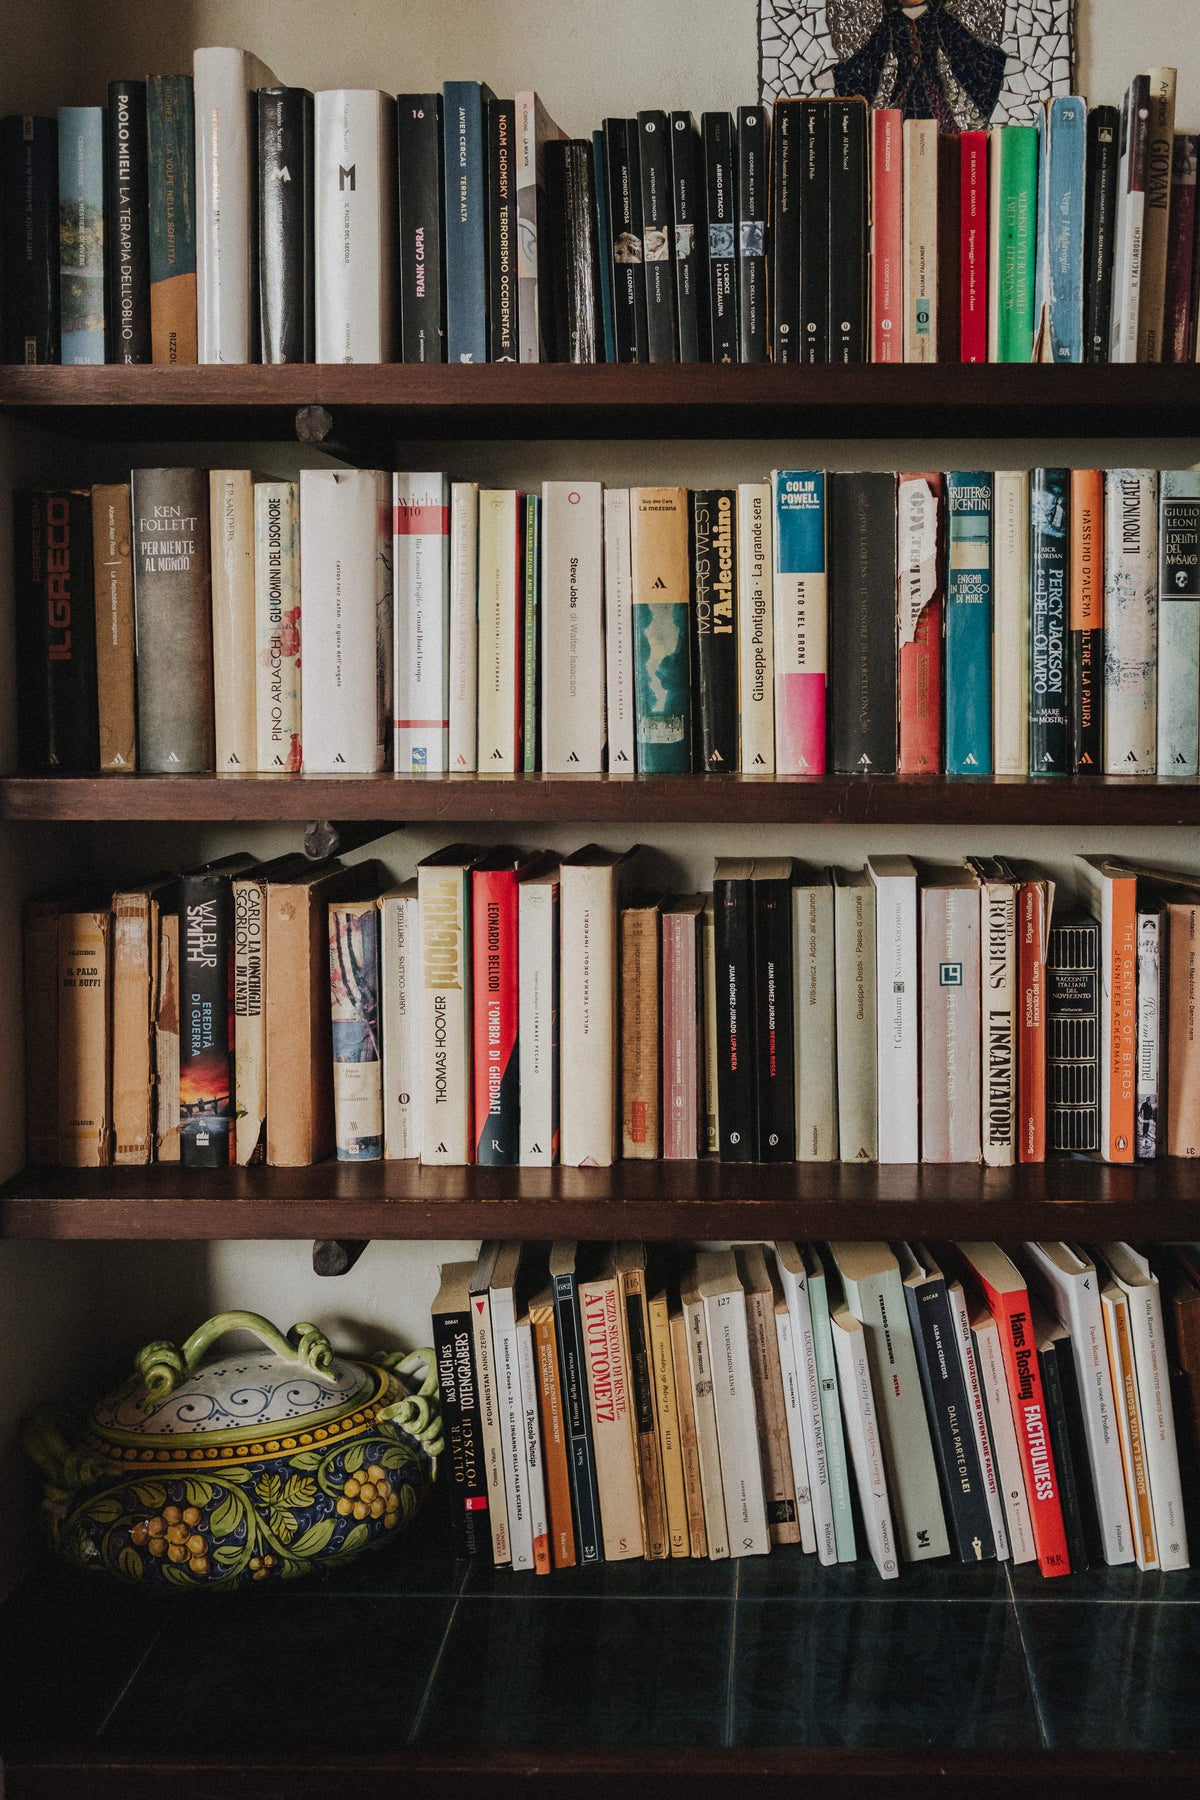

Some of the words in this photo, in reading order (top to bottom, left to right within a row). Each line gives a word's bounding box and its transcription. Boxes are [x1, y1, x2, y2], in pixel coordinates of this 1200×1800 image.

[118, 95, 130, 140] PAOLO
[412, 109, 424, 119] 16
[1062, 111, 1074, 120] 79
[119, 143, 131, 180] MIELI
[339, 164, 356, 191] M
[499, 149, 508, 199] CHOMSKY
[1149, 140, 1170, 209] GIOVANI
[120, 186, 131, 203] LA
[120, 207, 132, 262] TERAPIA
[416, 227, 424, 260] CAPRA
[500, 206, 508, 272] TERRORISMO
[416, 263, 425, 297] FRANK
[121, 265, 134, 339] DELL'OBLIO
[501, 276, 510, 347] OCCIDENTALE
[781, 493, 820, 504] POWELL
[786, 481, 815, 491] COLIN
[140, 518, 198, 532] FOLLETT
[154, 506, 180, 518] KEN
[268, 498, 281, 547] DISONORE
[753, 498, 761, 520] sera
[1122, 480, 1140, 541] PROVINCIALE
[1164, 508, 1200, 517] GIULIO
[1167, 518, 1198, 527] LEONI
[695, 502, 709, 555] WEST
[752, 524, 763, 561] grande
[1082, 509, 1090, 562] MASSIMO
[142, 541, 158, 556] PER
[160, 541, 195, 555] NIENTE
[145, 558, 157, 572] AL
[158, 556, 190, 572] MONDO
[270, 550, 282, 566] DEL
[712, 497, 732, 634] l'Arlecchino
[1122, 543, 1140, 554] IL
[270, 569, 282, 607] UOMINI
[570, 557, 579, 584] Steve
[752, 564, 763, 577] La
[957, 574, 982, 584] ENIGMA
[570, 586, 579, 608] Jobs
[696, 560, 710, 634] MORRIS
[950, 584, 958, 594] IN
[959, 584, 990, 594] LUOGO
[956, 594, 963, 604] DI
[965, 594, 984, 604] MARE
[1048, 569, 1062, 618] PERCY
[1082, 567, 1090, 618] D'ALEMA
[270, 608, 282, 622] GLI
[570, 613, 579, 622] di
[752, 591, 765, 644] Pontiggia
[570, 624, 579, 654] Walter
[1047, 620, 1063, 693] JACKSON
[1081, 630, 1090, 666] OLTRE
[271, 636, 282, 702] ARLACCHI
[415, 656, 423, 682] Europa
[569, 655, 578, 697] Isaacson
[752, 648, 764, 702] Giuseppe
[1081, 671, 1090, 685] LA
[271, 704, 282, 741] PINO
[1081, 690, 1090, 728] PAURA
[236, 888, 248, 955] SGORLON
[248, 888, 261, 936] CARLO
[487, 902, 499, 951] LEONARDO
[186, 906, 203, 962] SMITH
[200, 900, 217, 968] WILBUR
[248, 940, 261, 954] LA
[989, 899, 1006, 989] ROBBINS
[1124, 923, 1132, 951] THE
[247, 955, 262, 1017] CONCHIGLIA
[488, 955, 500, 992] BELLODI
[1123, 958, 1133, 1017] GENIUS
[191, 993, 201, 1006] DI
[729, 983, 737, 1034] GÓMEZ-JURADO
[191, 1008, 201, 1056] GUERRA
[201, 1002, 215, 1049] EREDITÀ
[434, 995, 448, 1048] HOOVER
[488, 1001, 500, 1045] L'OMBRA
[1123, 1025, 1132, 1044] OF
[488, 1050, 500, 1061] DI
[1113, 1011, 1121, 1074] ACKERMAN
[435, 1052, 447, 1104] THOMAS
[488, 1066, 501, 1115] GHEDDAFI
[989, 1010, 1011, 1146] L'INCANTATORE
[1122, 1054, 1131, 1100] BIRDS
[584, 1292, 603, 1307] A
[605, 1290, 618, 1323] MEZZO
[717, 1298, 730, 1307] 127
[878, 1294, 889, 1328] FERNANDO
[479, 1329, 488, 1348] ZERO
[803, 1330, 814, 1356] LUCIO
[959, 1310, 970, 1342] MURGIA
[1009, 1312, 1030, 1348] Hans
[441, 1344, 451, 1358] DES
[480, 1349, 489, 1372] ANNO
[608, 1325, 622, 1364] SECOLO
[883, 1330, 895, 1364] ARAMBURU
[932, 1324, 941, 1340] ALBA
[937, 1349, 949, 1379] CÉSPEDES
[440, 1360, 456, 1387] BUCH
[454, 1333, 475, 1411] TOTENGRÄBERS
[586, 1309, 615, 1424] TUTTOMETZ
[612, 1365, 623, 1377] DI
[806, 1357, 819, 1411] CARACCIOLO
[964, 1347, 979, 1394] ISTRUZIONI
[1015, 1350, 1036, 1400] Rosling
[444, 1389, 456, 1402] DAS
[482, 1374, 494, 1427] AFGHANISTAN
[892, 1374, 901, 1397] PATRIA
[973, 1395, 982, 1410] PER
[526, 1417, 536, 1441] Piccolo
[946, 1405, 959, 1435] DALLA
[975, 1411, 990, 1458] DIVENTARE
[526, 1442, 538, 1468] Principe
[951, 1436, 964, 1465] PARTE
[1023, 1404, 1054, 1501] FACTFULNESS
[958, 1466, 966, 1476] DI
[960, 1478, 971, 1493] LEI
[984, 1459, 996, 1494] FASCISTI
